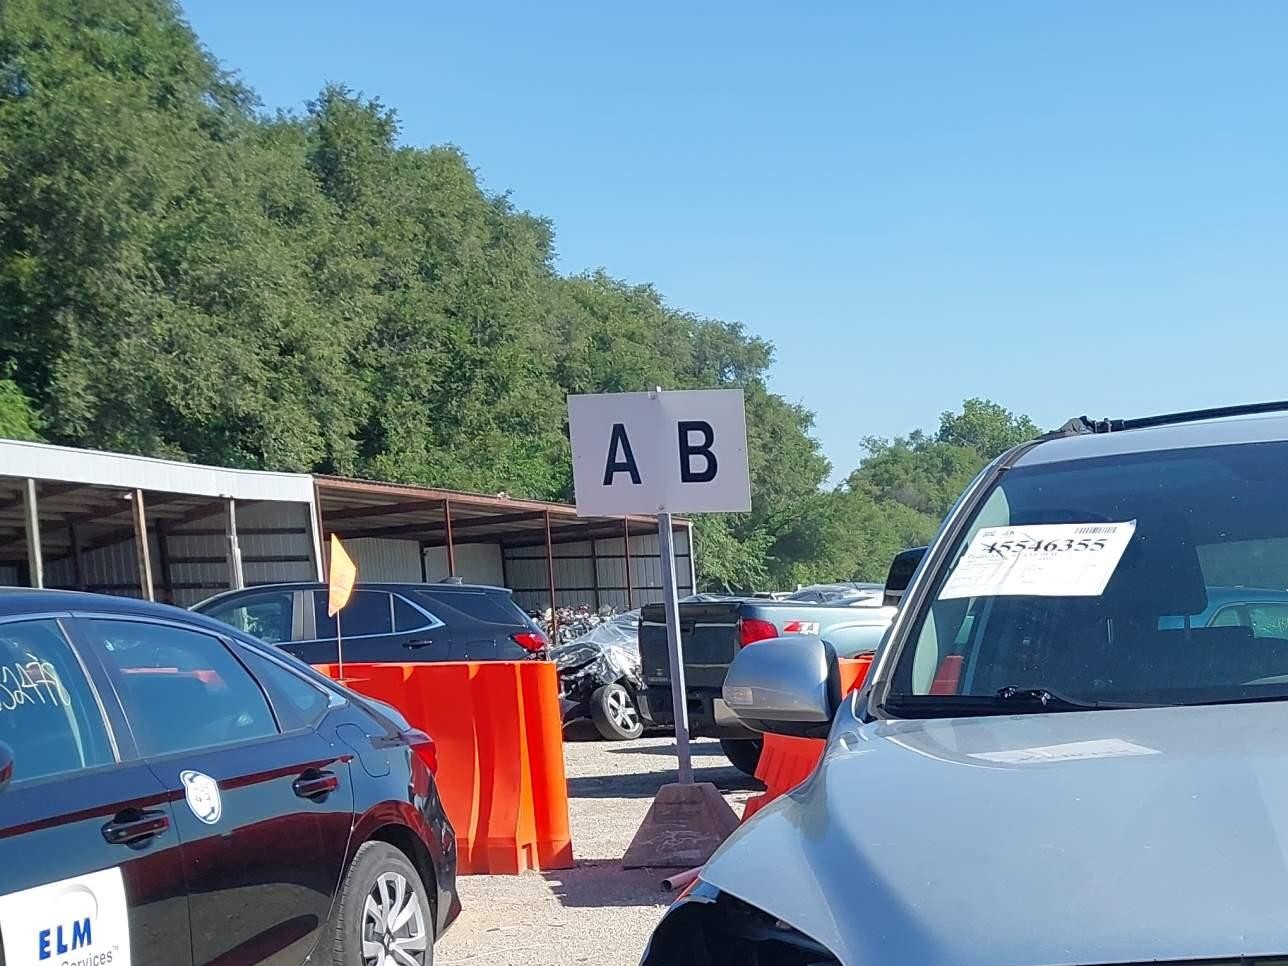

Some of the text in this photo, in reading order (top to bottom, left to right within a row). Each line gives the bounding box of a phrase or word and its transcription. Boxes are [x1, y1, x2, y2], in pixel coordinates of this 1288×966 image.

[603, 420, 718, 485] A B
[39, 917, 92, 960] ELM
